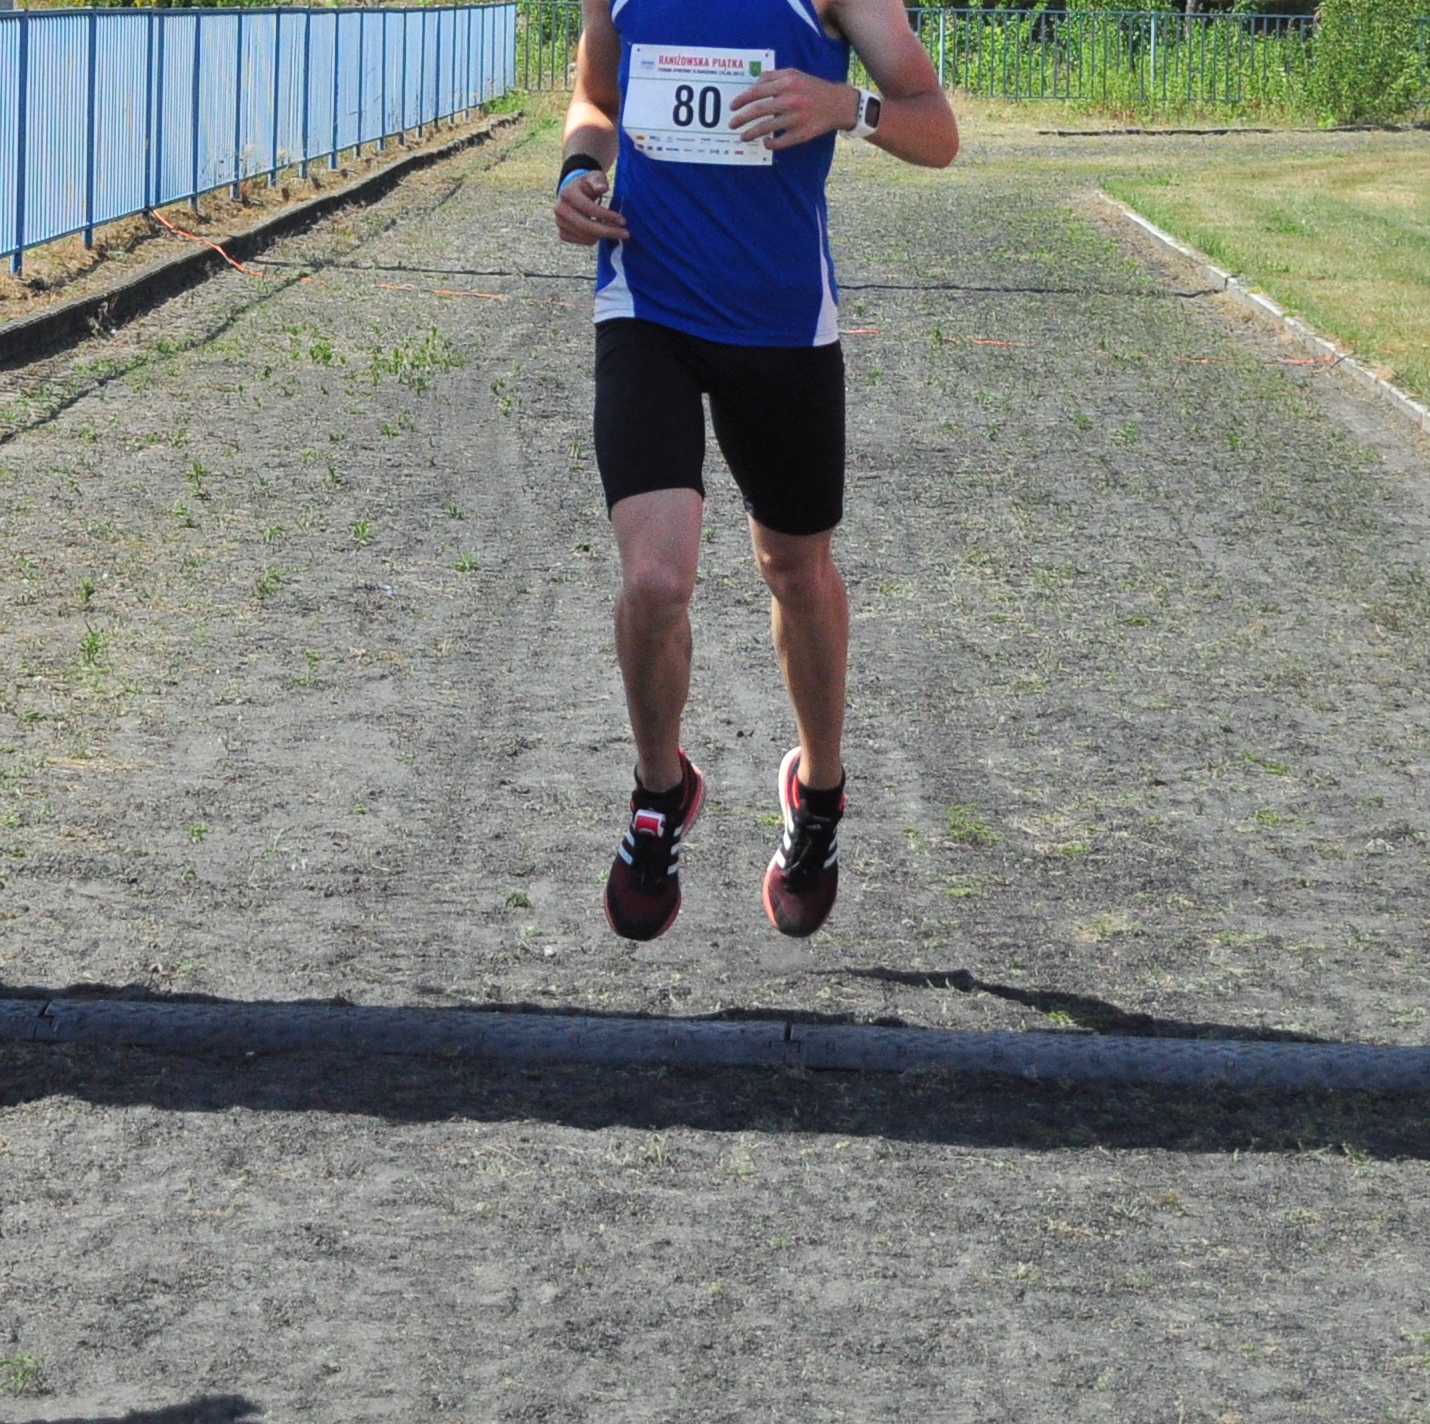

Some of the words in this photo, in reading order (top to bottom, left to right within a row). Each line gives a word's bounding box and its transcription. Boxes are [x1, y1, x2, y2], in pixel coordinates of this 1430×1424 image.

[658, 54, 709, 66] RANIŻOWSKA
[712, 57, 744, 71] PIĄTKA
[673, 84, 721, 128] 80
